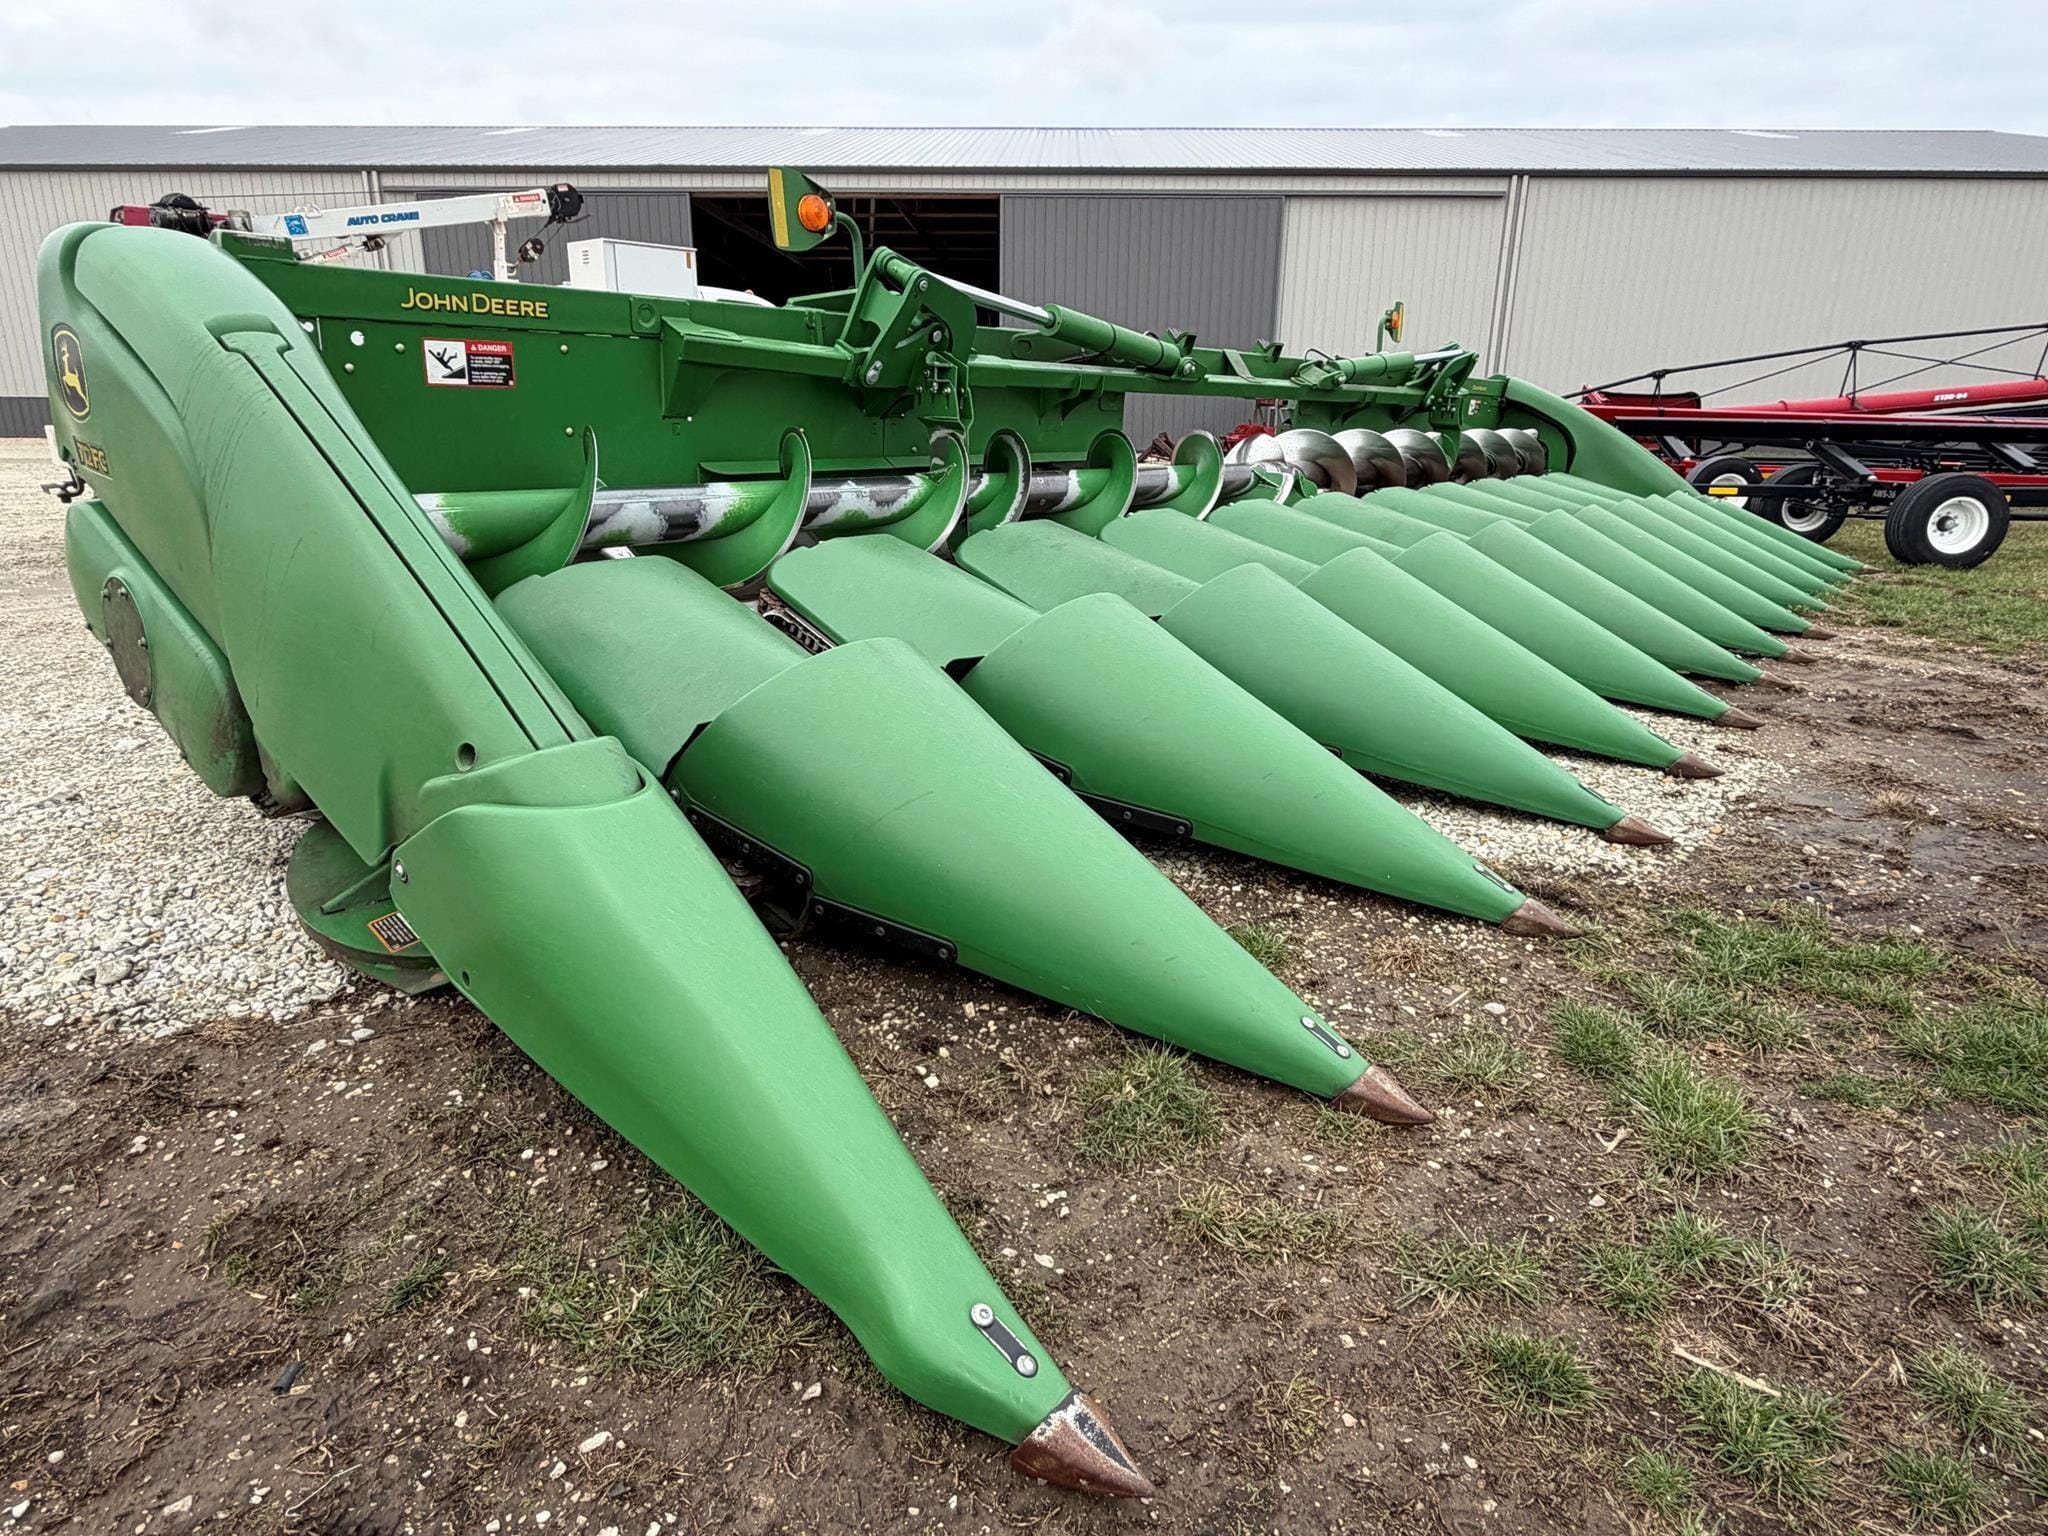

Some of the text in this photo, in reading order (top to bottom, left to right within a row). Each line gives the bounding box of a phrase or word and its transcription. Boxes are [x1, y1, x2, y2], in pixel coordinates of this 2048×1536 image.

[347, 211, 419, 226] AUTO CRANE
[400, 287, 549, 319] JOHN DEERE
[477, 343, 507, 352] DANGER
